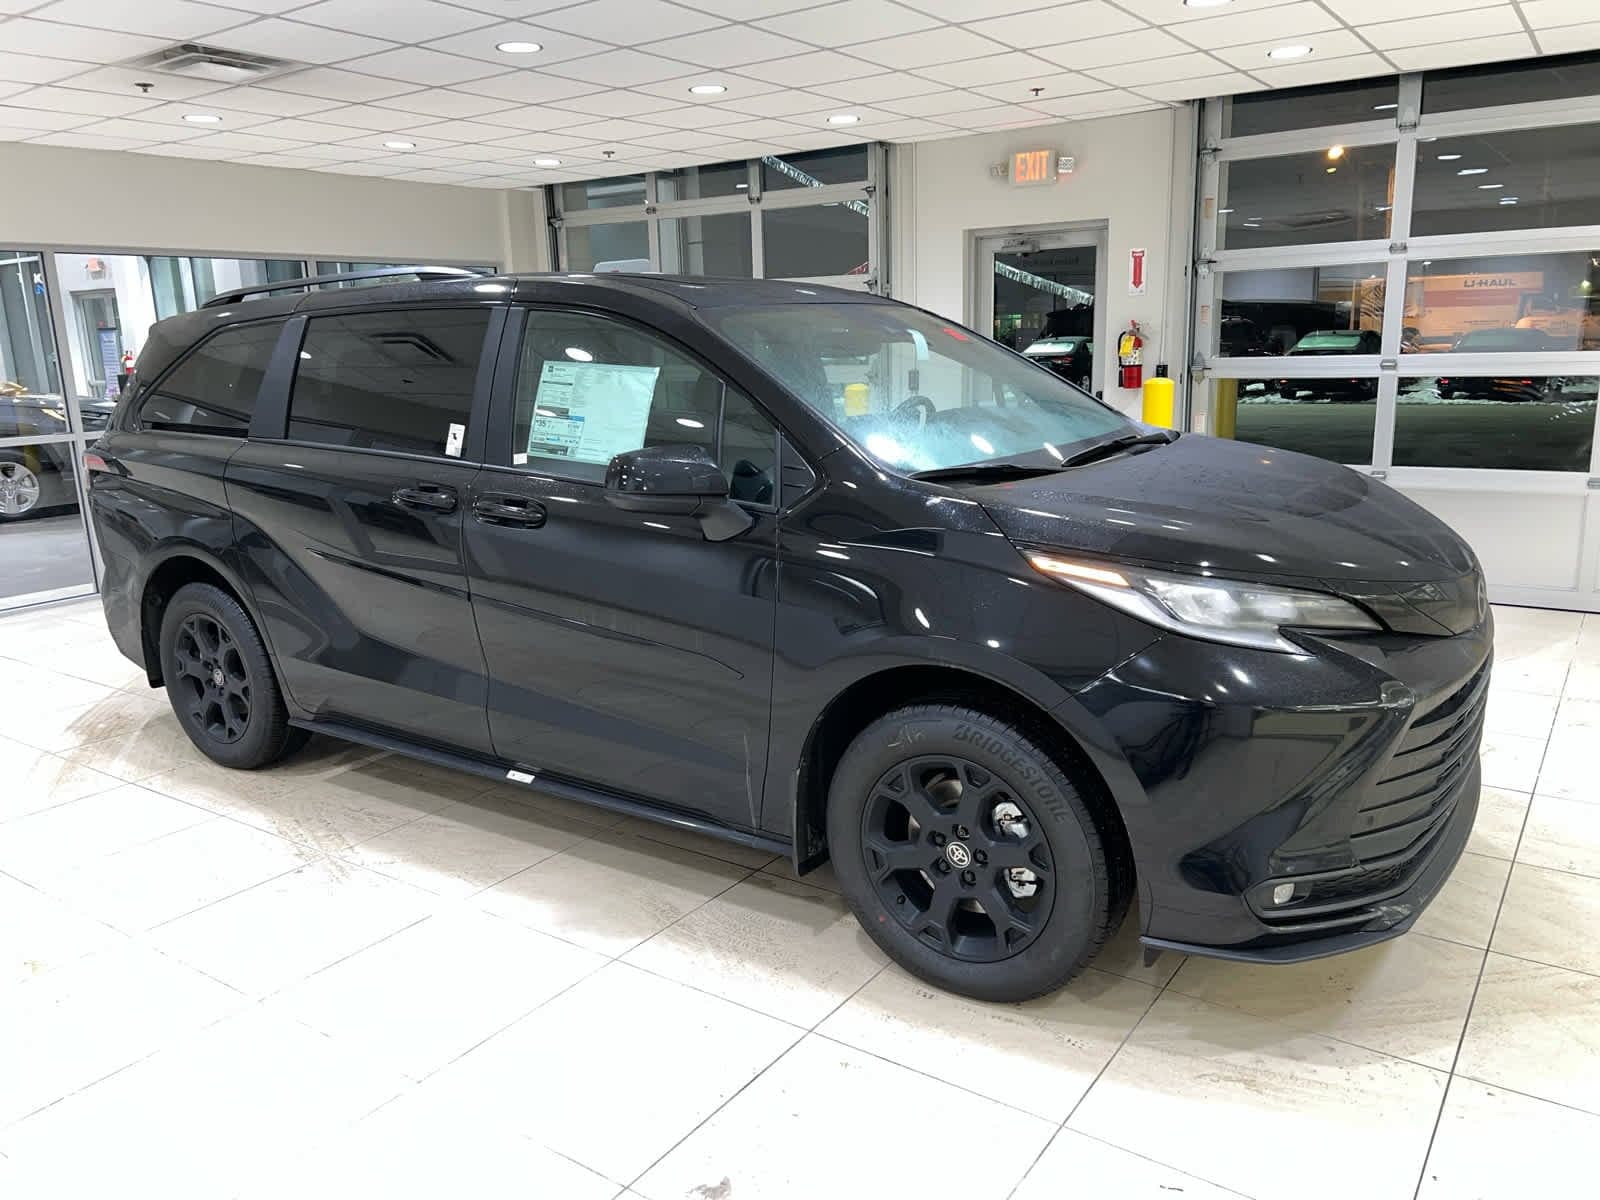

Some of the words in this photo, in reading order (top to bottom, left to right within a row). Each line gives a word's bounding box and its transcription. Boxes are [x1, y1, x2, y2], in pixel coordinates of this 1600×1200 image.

[1015, 149, 1049, 182] EXIT
[1463, 279, 1517, 288] U-HAUL
[952, 724, 1069, 823] BRIDGESTONE
